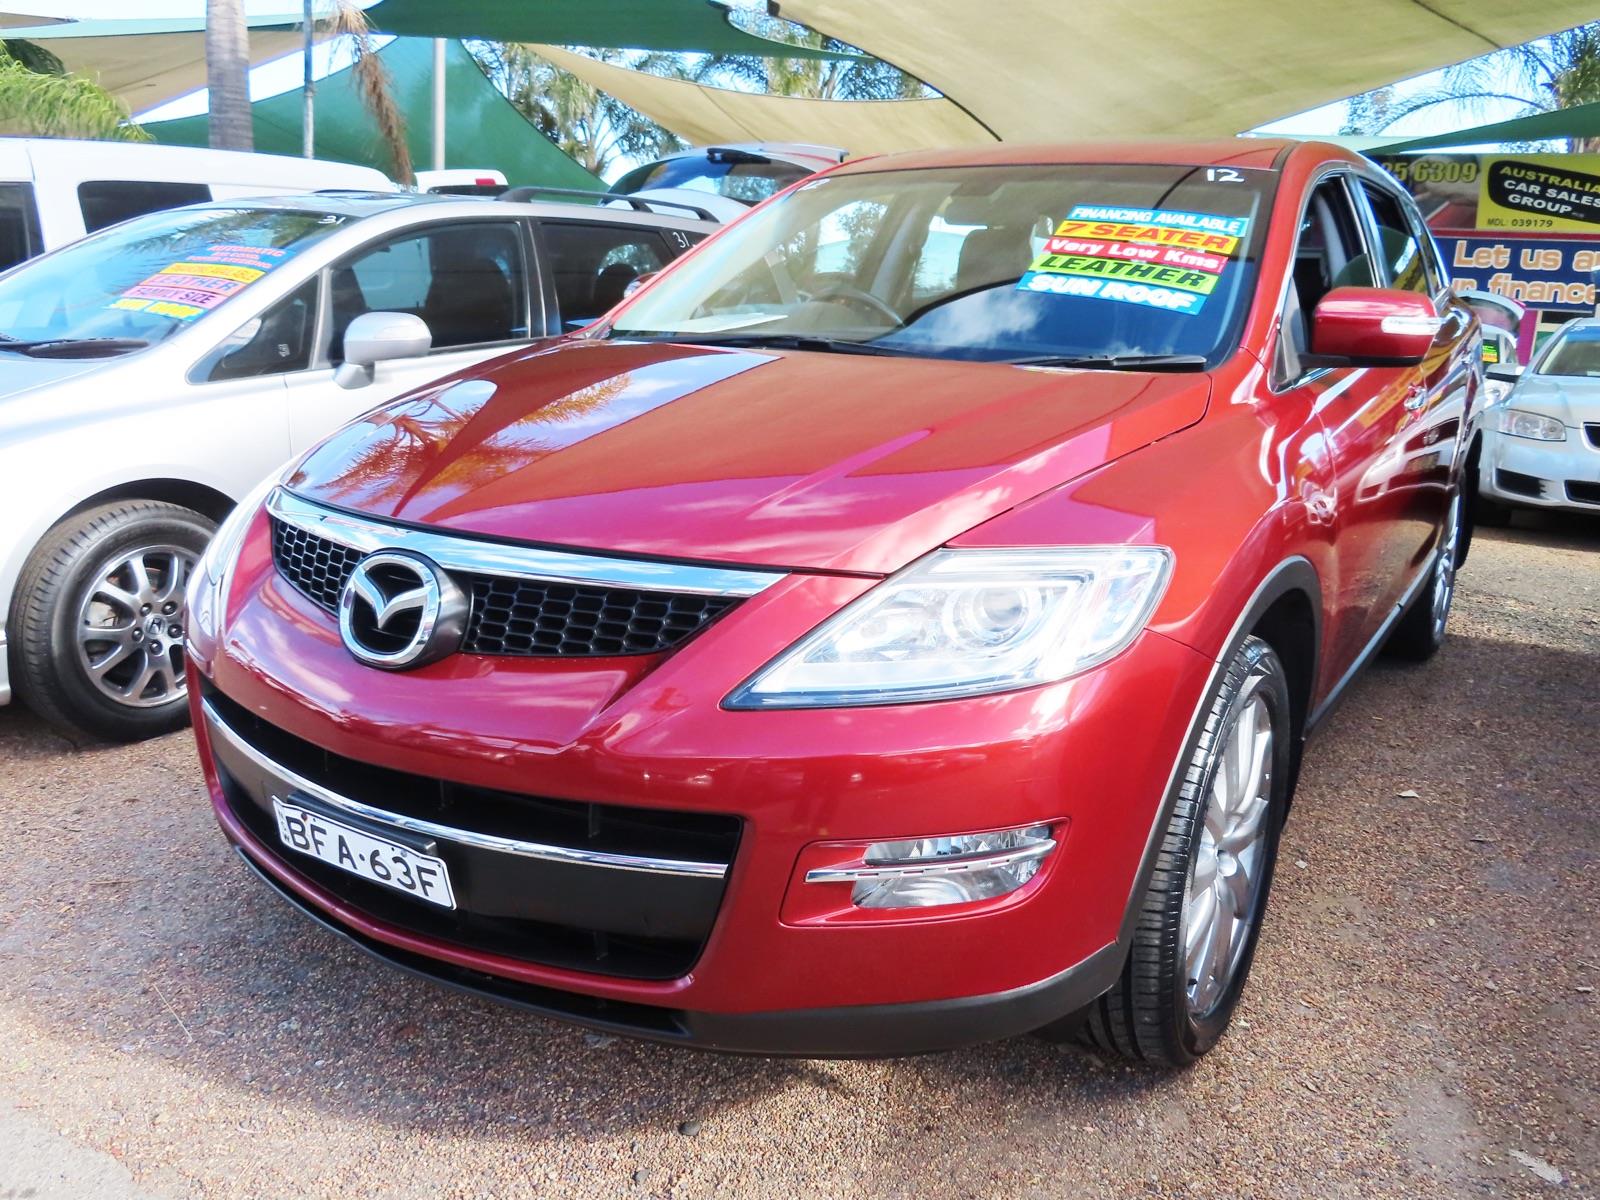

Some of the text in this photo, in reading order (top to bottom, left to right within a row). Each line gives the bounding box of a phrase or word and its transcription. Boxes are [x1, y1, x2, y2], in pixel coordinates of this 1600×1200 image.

[1207, 169, 1244, 182] 12
[1414, 161, 1477, 182] 6309
[1503, 180, 1600, 208] CAR SALES
[1508, 194, 1572, 213] GROUP
[1071, 207, 1241, 233] FINANCING AVAILABLE
[1511, 218, 1553, 227] 039179
[673, 232, 690, 248] 31
[1063, 223, 1231, 250] 7 SEATER
[1050, 239, 1220, 269] Very Low Kms
[1453, 240, 1511, 269] Let
[1520, 249, 1562, 271] us
[151, 274, 238, 292] LEATHER
[1040, 256, 1207, 287] LEATHER
[178, 291, 217, 304] SIZE
[1028, 274, 1198, 309] SUN ROOF
